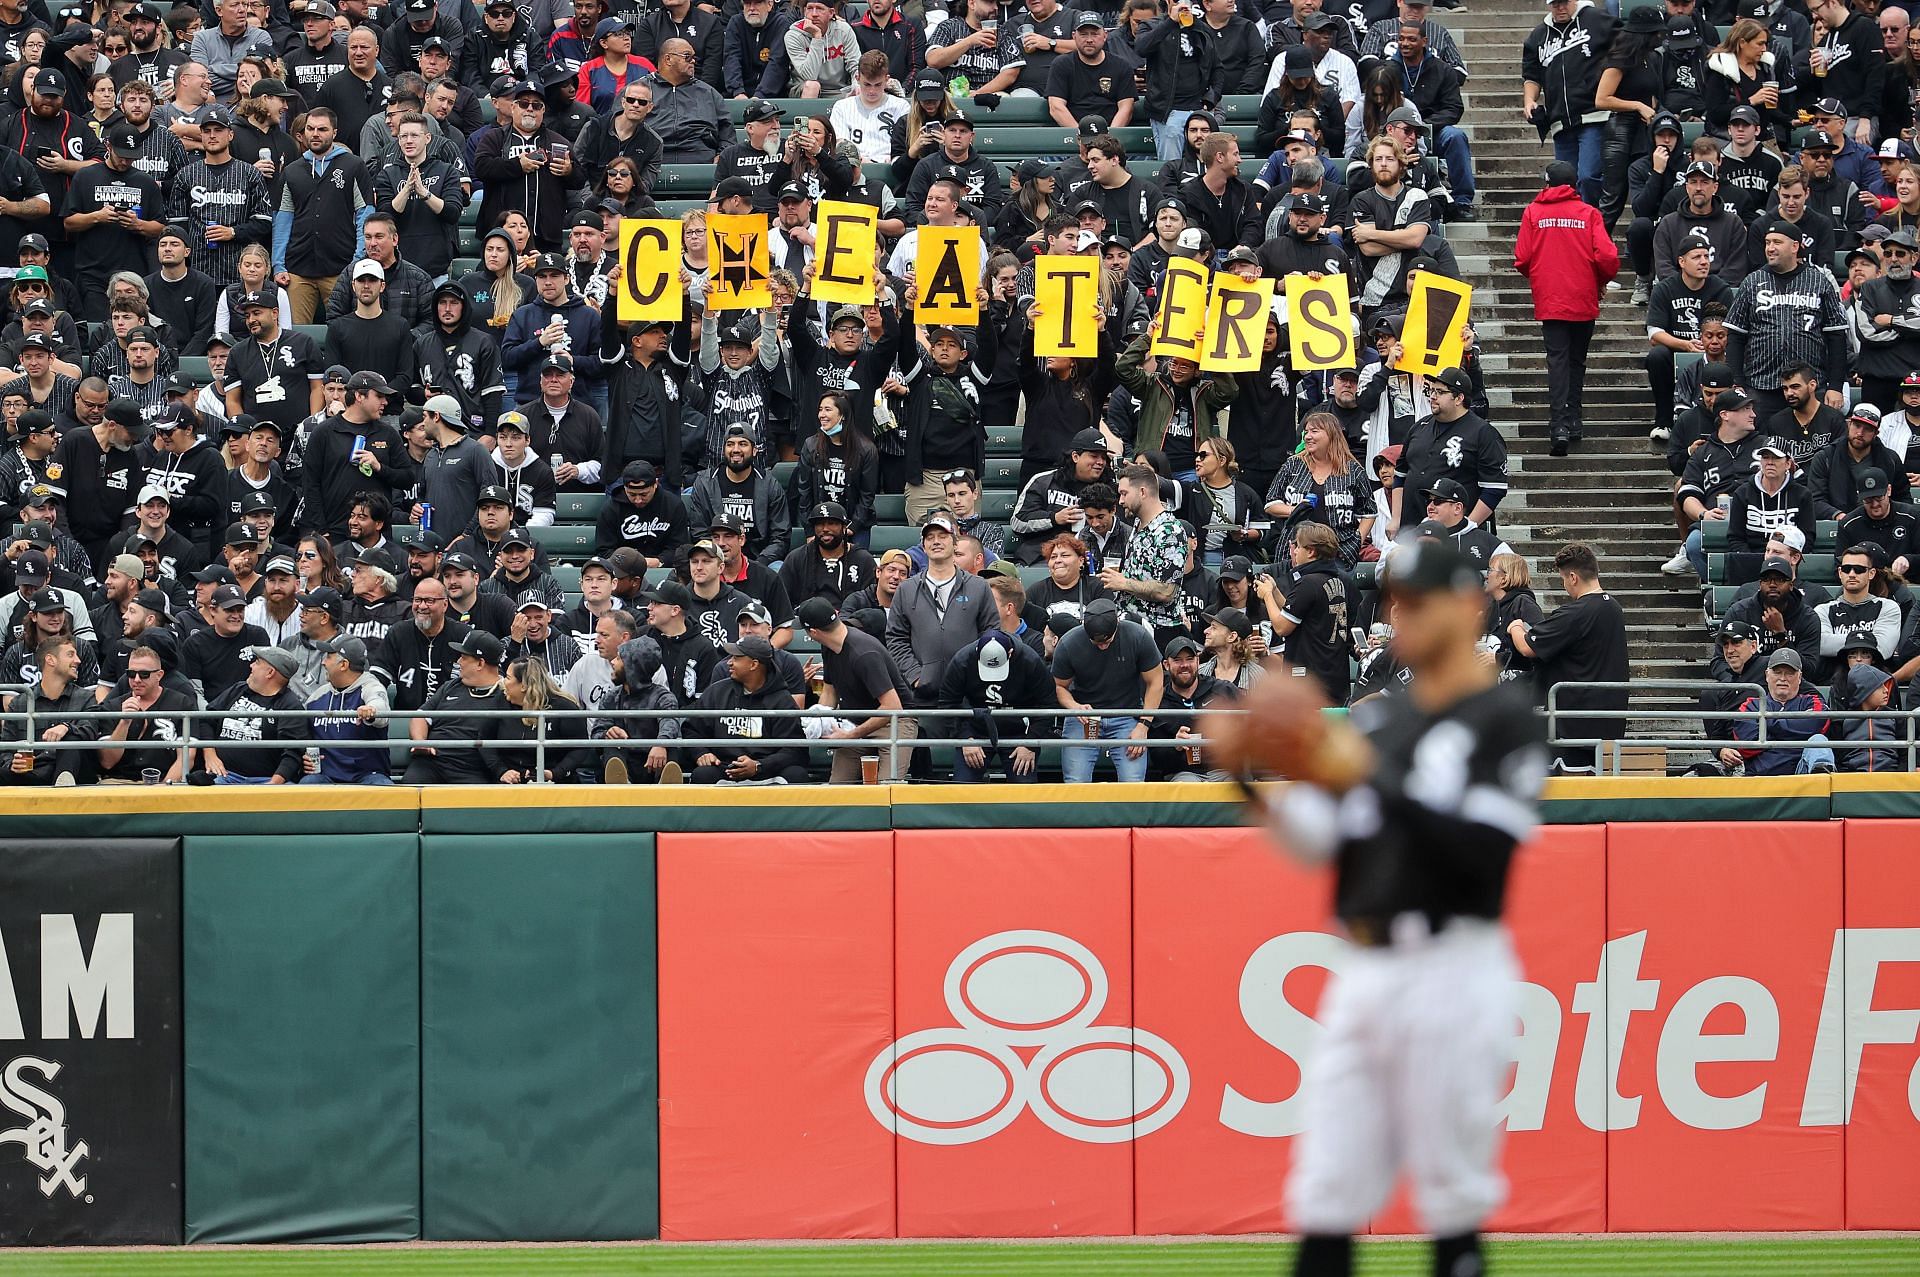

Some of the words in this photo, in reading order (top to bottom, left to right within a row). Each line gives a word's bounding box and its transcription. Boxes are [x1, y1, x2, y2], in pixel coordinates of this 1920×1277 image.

[1538, 37, 1563, 63] White
[1565, 26, 1590, 46] Sox
[737, 152, 783, 167] CHICAGO
[94, 192, 141, 204] CHAMPIONS
[190, 185, 247, 209] Southside
[1538, 218, 1557, 229] GUEST
[1558, 218, 1586, 230] SERVICES
[627, 226, 669, 306] C
[716, 232, 755, 293] H
[819, 215, 871, 286] E
[920, 239, 972, 309] A
[1047, 271, 1091, 349] T
[1156, 268, 1203, 350] E
[1209, 288, 1262, 359] R
[1299, 289, 1348, 365] S
[1422, 286, 1462, 367] !
[1755, 290, 1823, 313] Southside
[1803, 314, 1815, 332] 7
[714, 388, 763, 414] Southside
[106, 478, 129, 491] SOX
[1336, 509, 1353, 525] 79
[0, 912, 135, 1040] M
